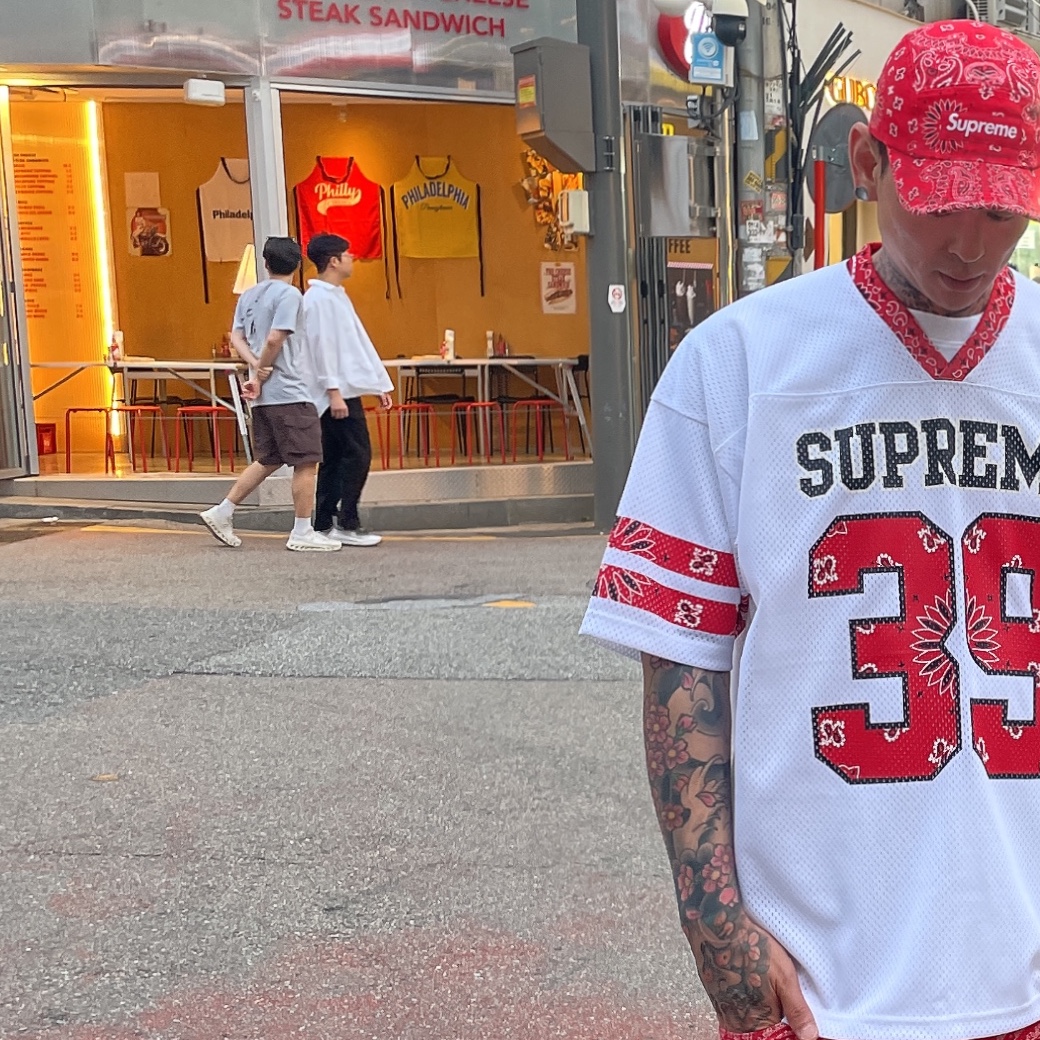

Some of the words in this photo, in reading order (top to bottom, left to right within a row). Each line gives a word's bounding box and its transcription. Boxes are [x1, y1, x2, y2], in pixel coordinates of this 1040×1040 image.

[278, 0, 361, 25] STEAK
[369, 5, 506, 37] SANDWICH
[946, 112, 1017, 139] Supreme
[314, 182, 362, 202] Philly
[401, 181, 471, 209] PHILADELPHIA
[668, 239, 691, 254] FFEE
